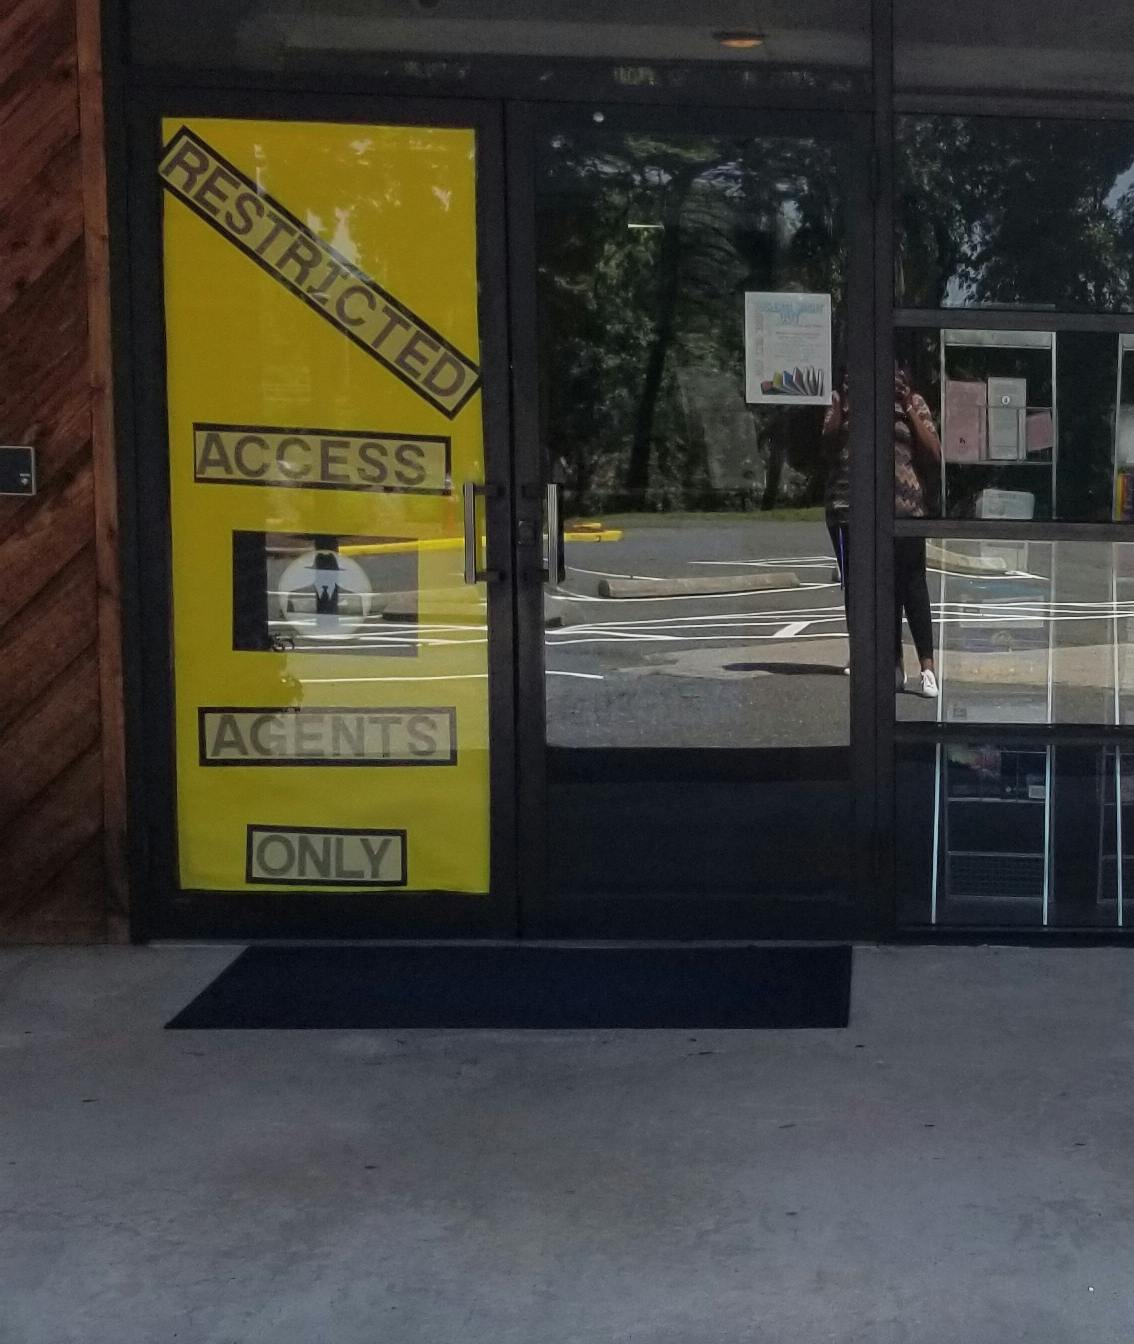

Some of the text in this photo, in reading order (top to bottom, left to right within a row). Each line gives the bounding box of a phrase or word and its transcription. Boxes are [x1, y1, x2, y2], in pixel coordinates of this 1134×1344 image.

[161, 140, 467, 398] RESTRICTED
[197, 432, 426, 486] ACCESS
[210, 714, 438, 757] AGENTS
[256, 834, 393, 879] ONLY
